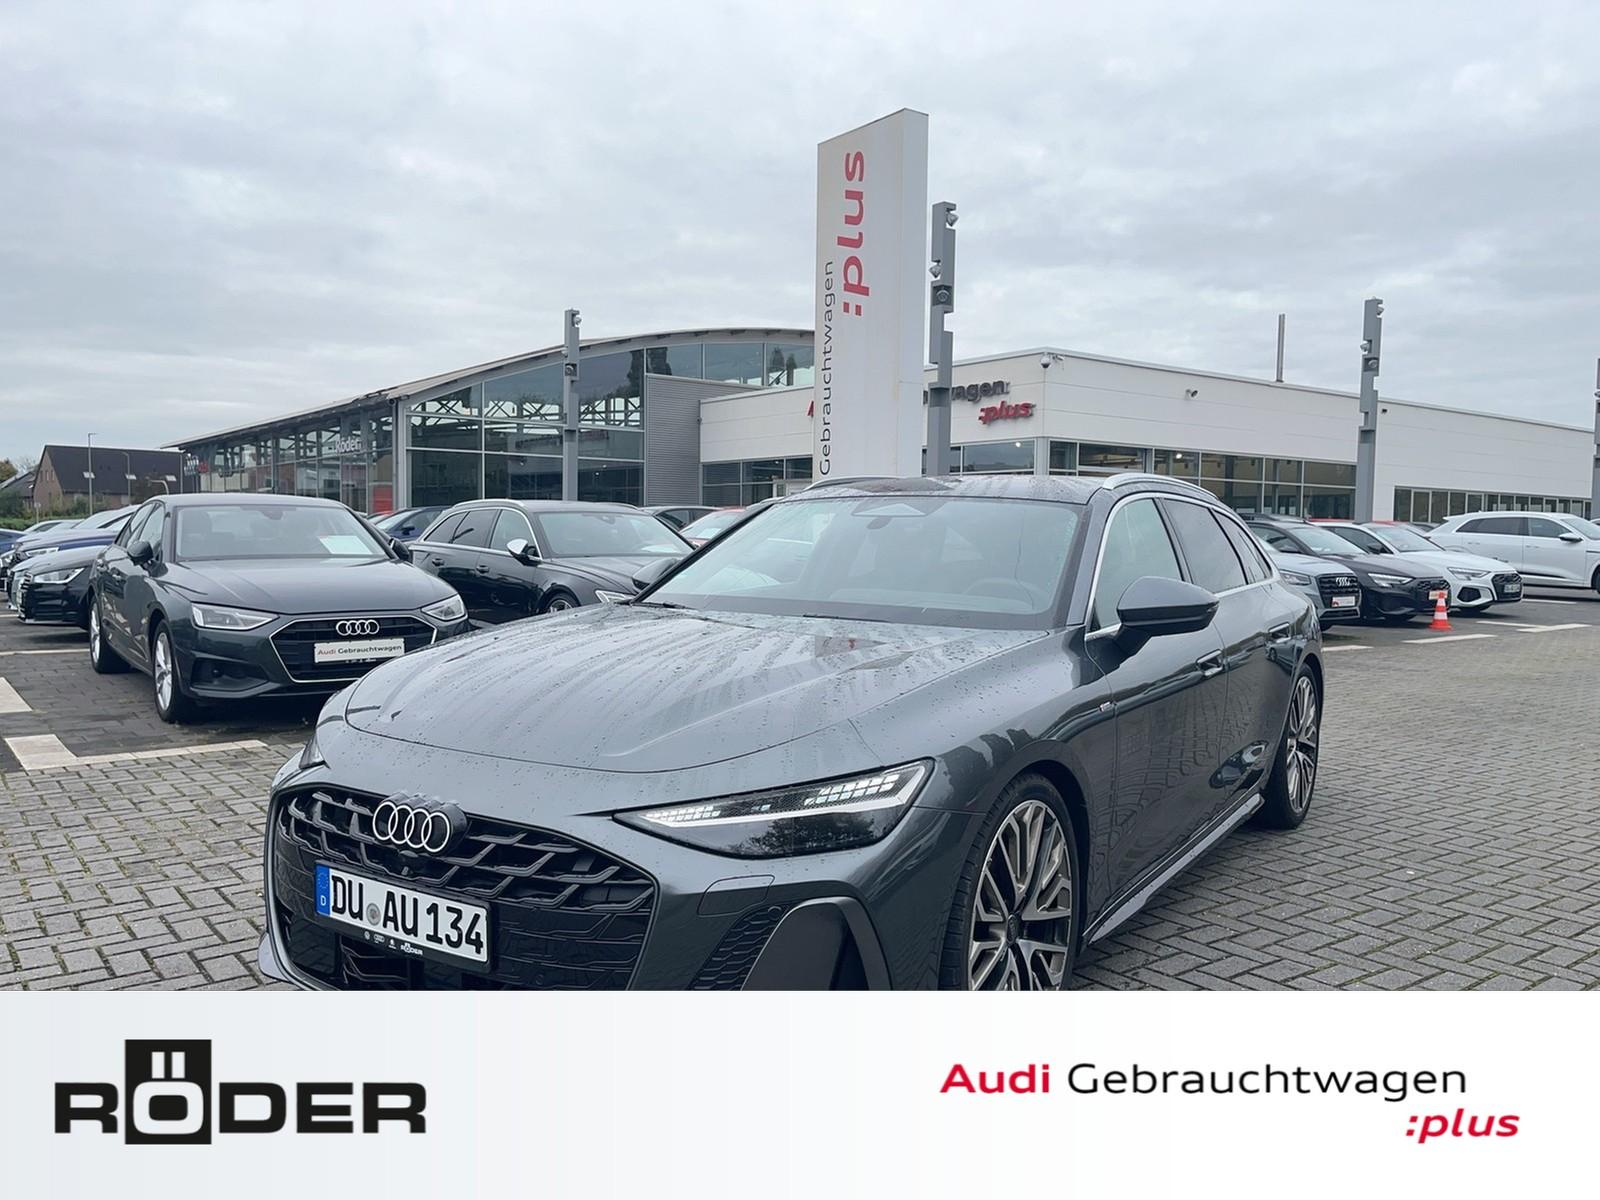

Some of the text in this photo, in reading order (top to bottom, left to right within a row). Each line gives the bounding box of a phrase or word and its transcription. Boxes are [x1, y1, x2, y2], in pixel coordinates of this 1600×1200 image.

[837, 151, 869, 317] :plus
[819, 261, 836, 476] Gebrauchtwagen
[337, 645, 402, 655] Gebrauchtwagen
[320, 895, 327, 906] D
[331, 875, 484, 955] DU AU 134
